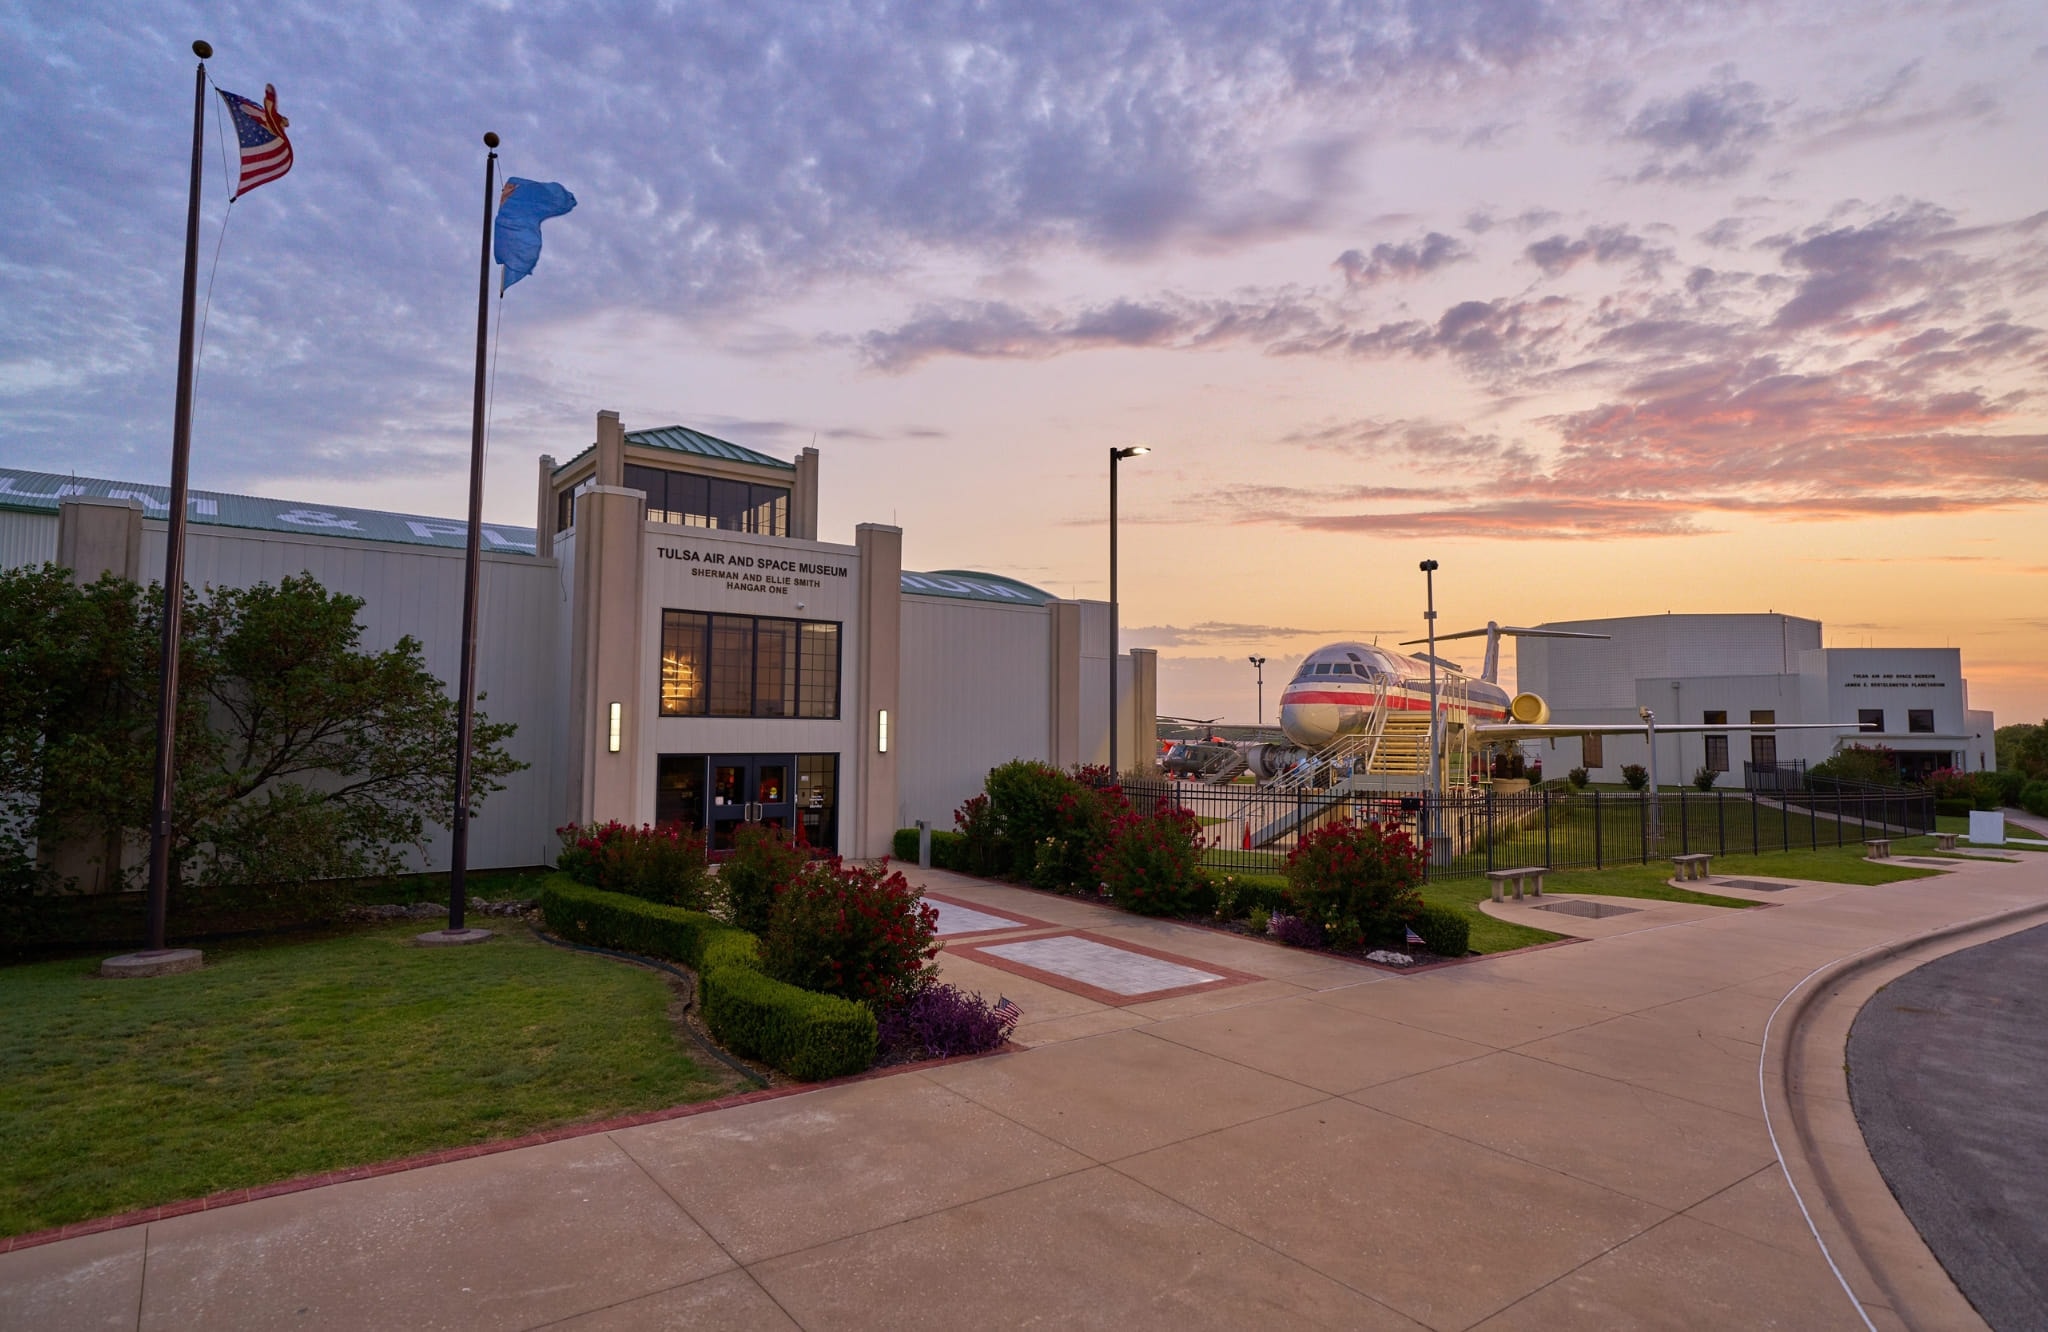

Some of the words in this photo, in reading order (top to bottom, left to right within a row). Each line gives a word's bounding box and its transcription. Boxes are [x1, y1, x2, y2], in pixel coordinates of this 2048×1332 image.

[656, 547, 701, 563] TULSA
[703, 552, 725, 565] AIR
[727, 555, 755, 568] AND
[757, 558, 797, 573] SPACE
[799, 562, 848, 578] MUSEUM
[691, 567, 739, 581] SHERMAN
[742, 573, 763, 583] AND
[765, 575, 791, 586] ELLIE
[794, 577, 821, 588] SMITH
[726, 581, 767, 593] HANGAR
[768, 586, 788, 595] ONE
